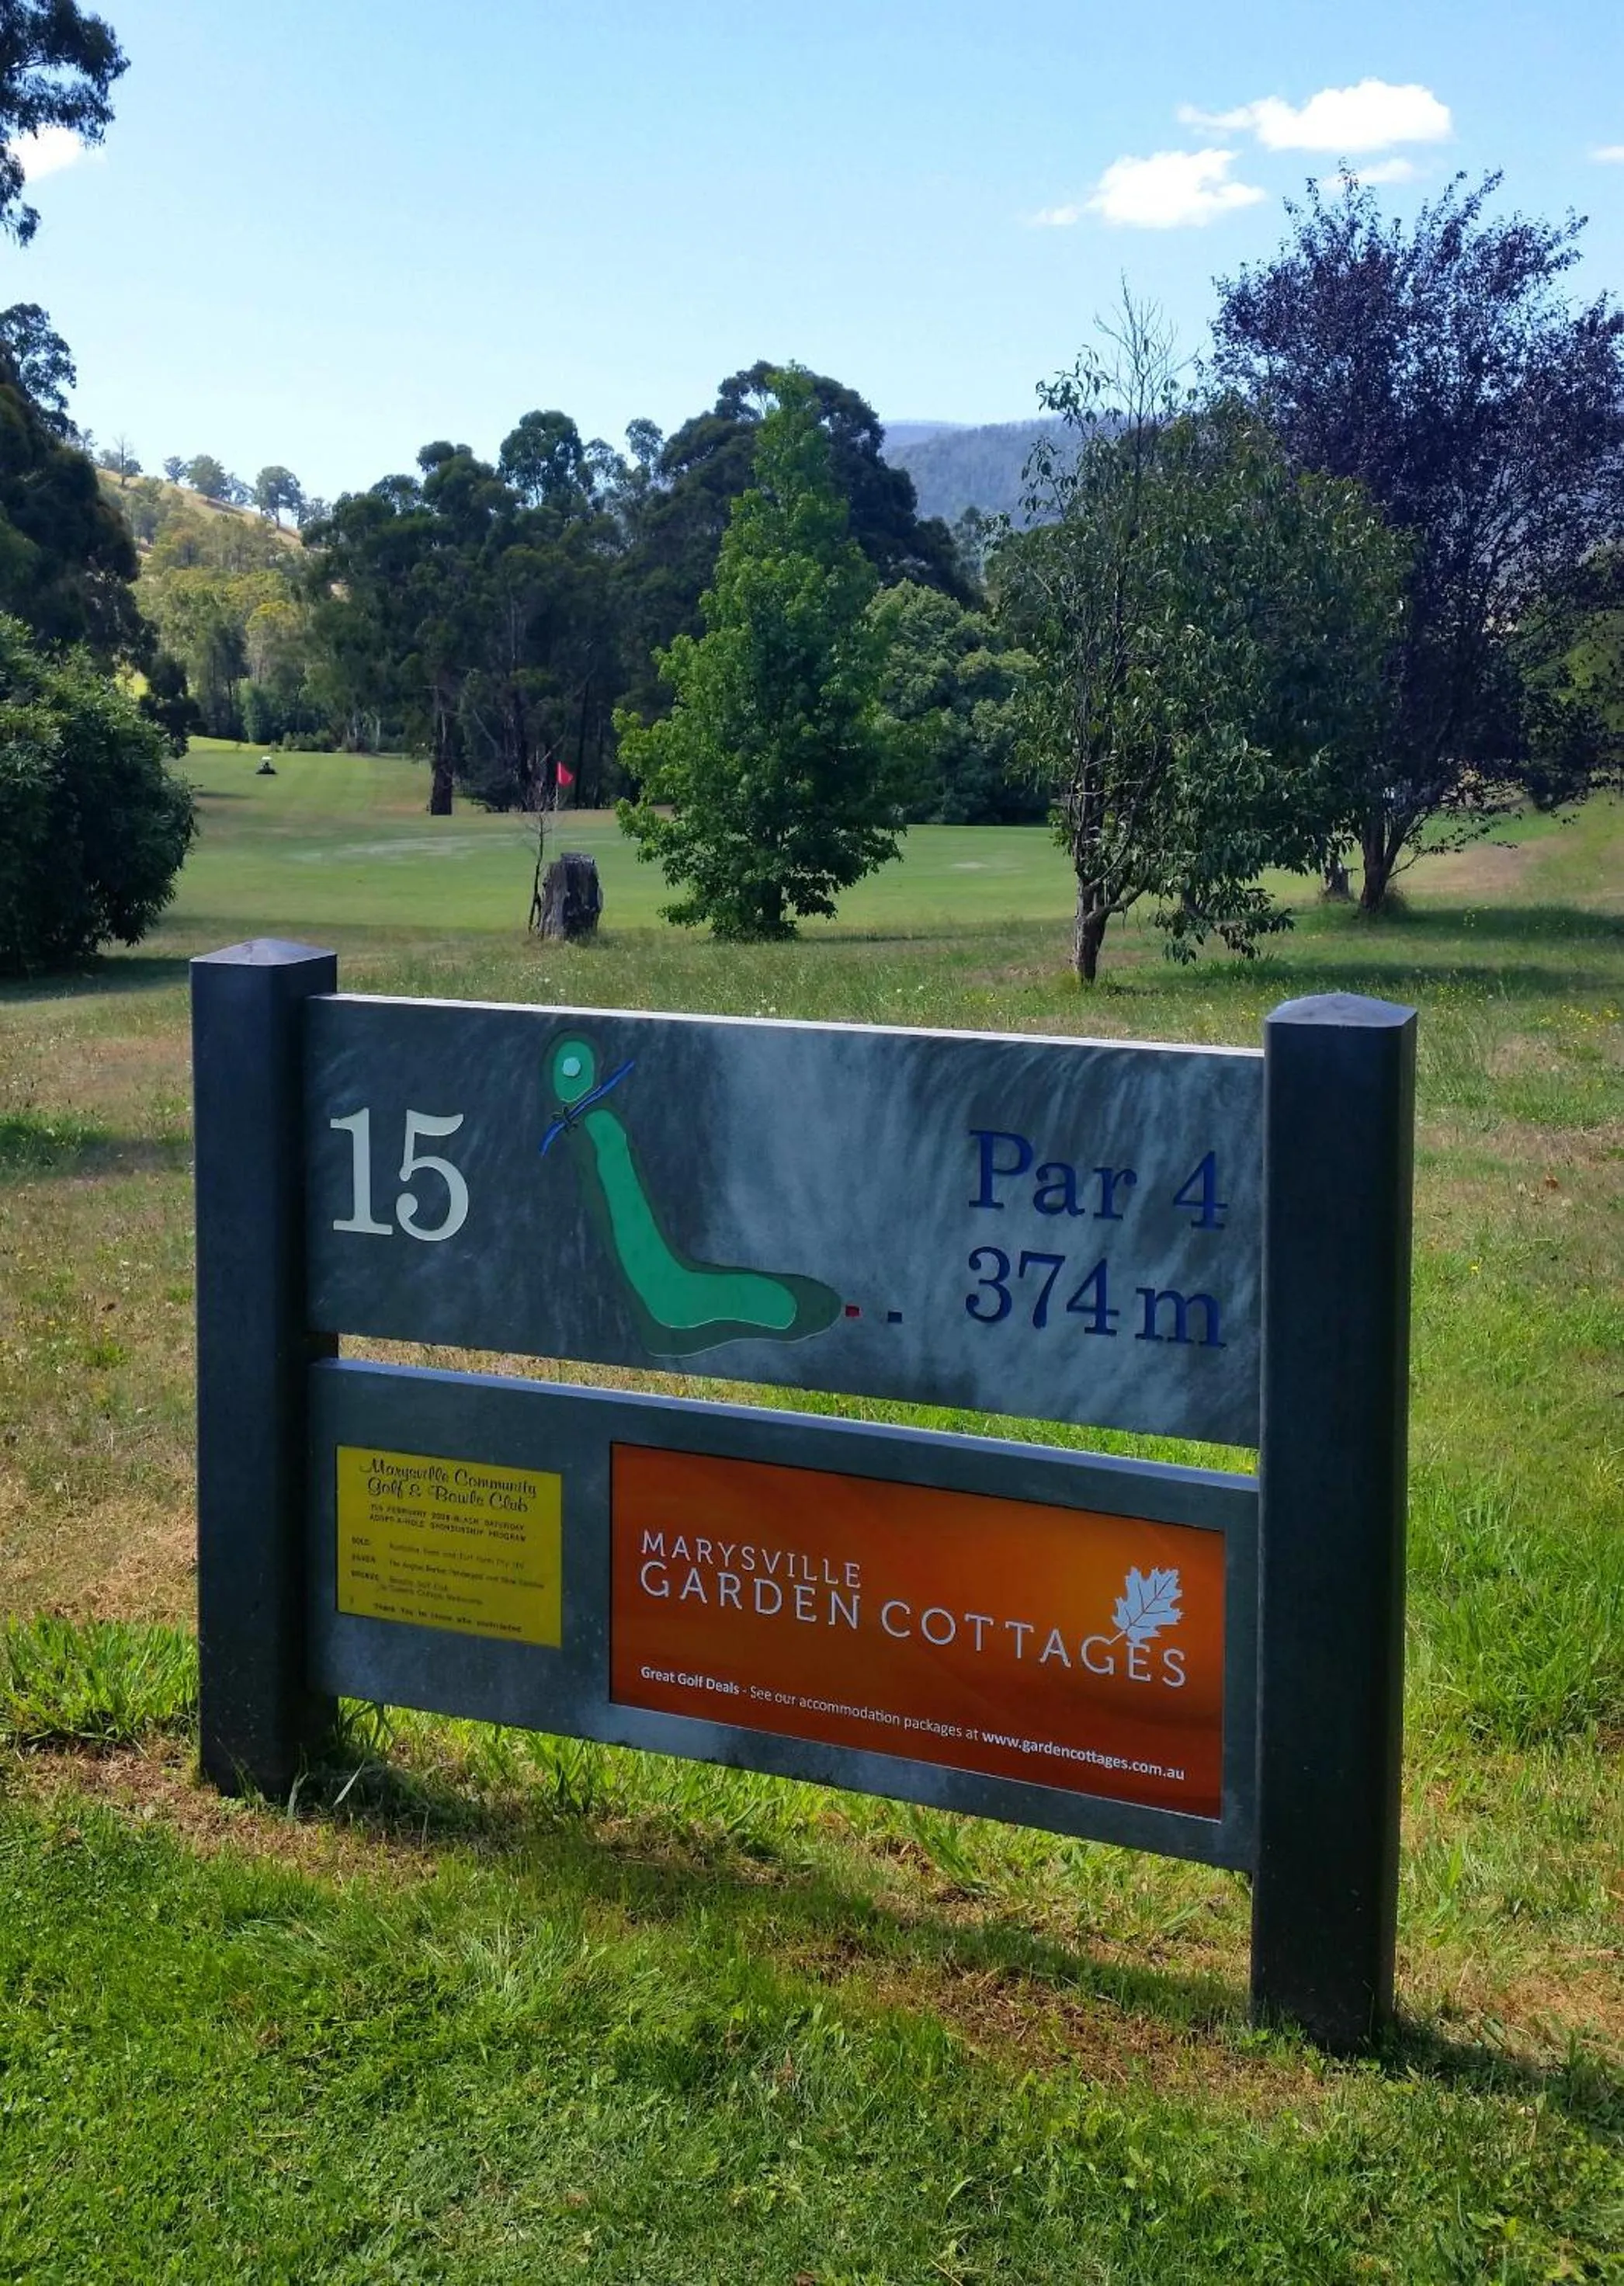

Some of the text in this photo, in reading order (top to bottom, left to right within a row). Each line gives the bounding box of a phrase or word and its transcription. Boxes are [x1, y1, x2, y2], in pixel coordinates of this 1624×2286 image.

[330, 1107, 469, 1242] 15
[968, 1129, 1229, 1230] Par 4
[360, 1457, 537, 1499] Marysville Community
[367, 1477, 404, 1499] Golf
[409, 1484, 422, 1498] &
[488, 1494, 529, 1513] Club
[640, 1529, 861, 1589] MARYSVILLE
[640, 1560, 1187, 1687] GARDEN COTTAGES
[640, 1666, 675, 1683] Great
[677, 1673, 703, 1688] Golf
[706, 1677, 740, 1695] Deals
[750, 1686, 772, 1701] See
[775, 1692, 796, 1705] our
[799, 1695, 900, 1726] accommodation
[904, 1716, 962, 1739] packages
[965, 1727, 979, 1741] at
[982, 1731, 1185, 1782] www.gardencottages.com.au
